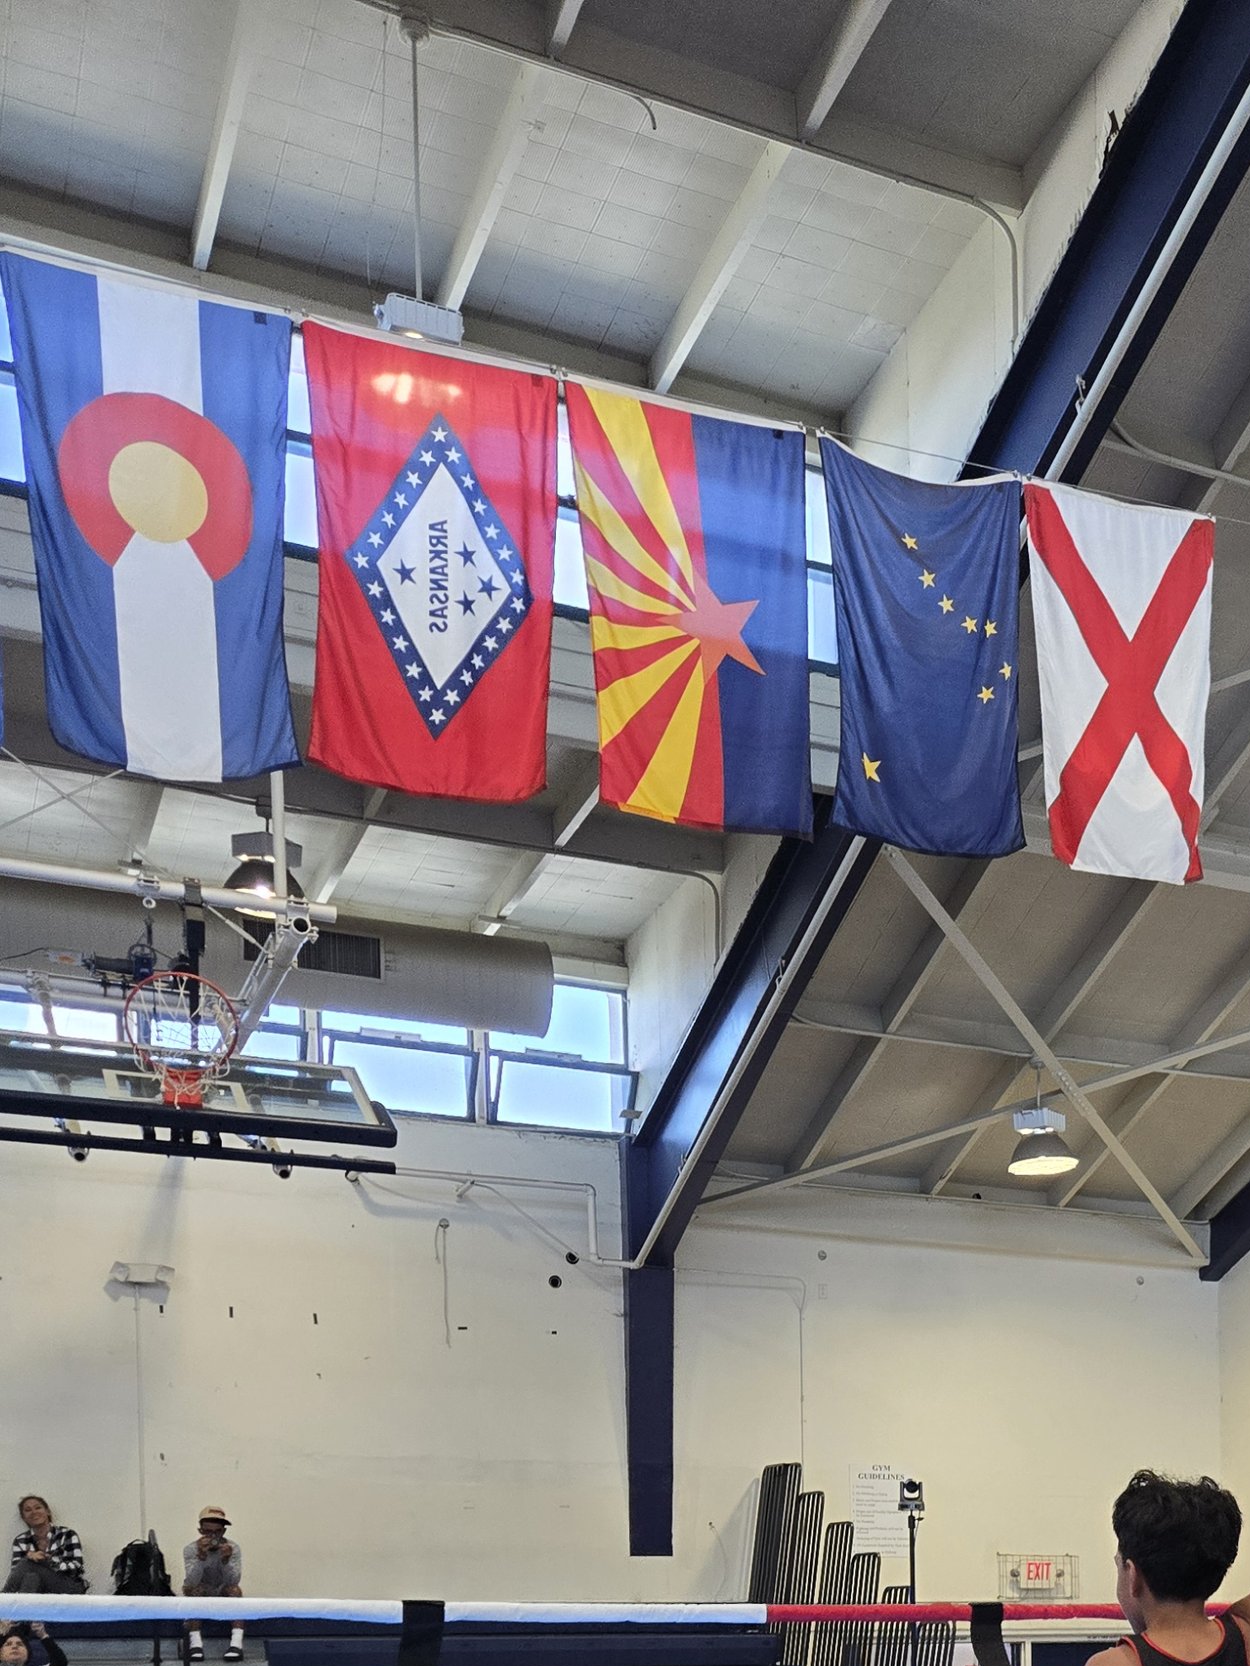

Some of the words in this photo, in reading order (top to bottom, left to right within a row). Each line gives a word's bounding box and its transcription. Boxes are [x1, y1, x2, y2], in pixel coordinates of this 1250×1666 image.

[872, 1464, 891, 1472] GYM
[858, 1472, 905, 1481] GUIDELINES
[1026, 1562, 1052, 1581] EXIT
